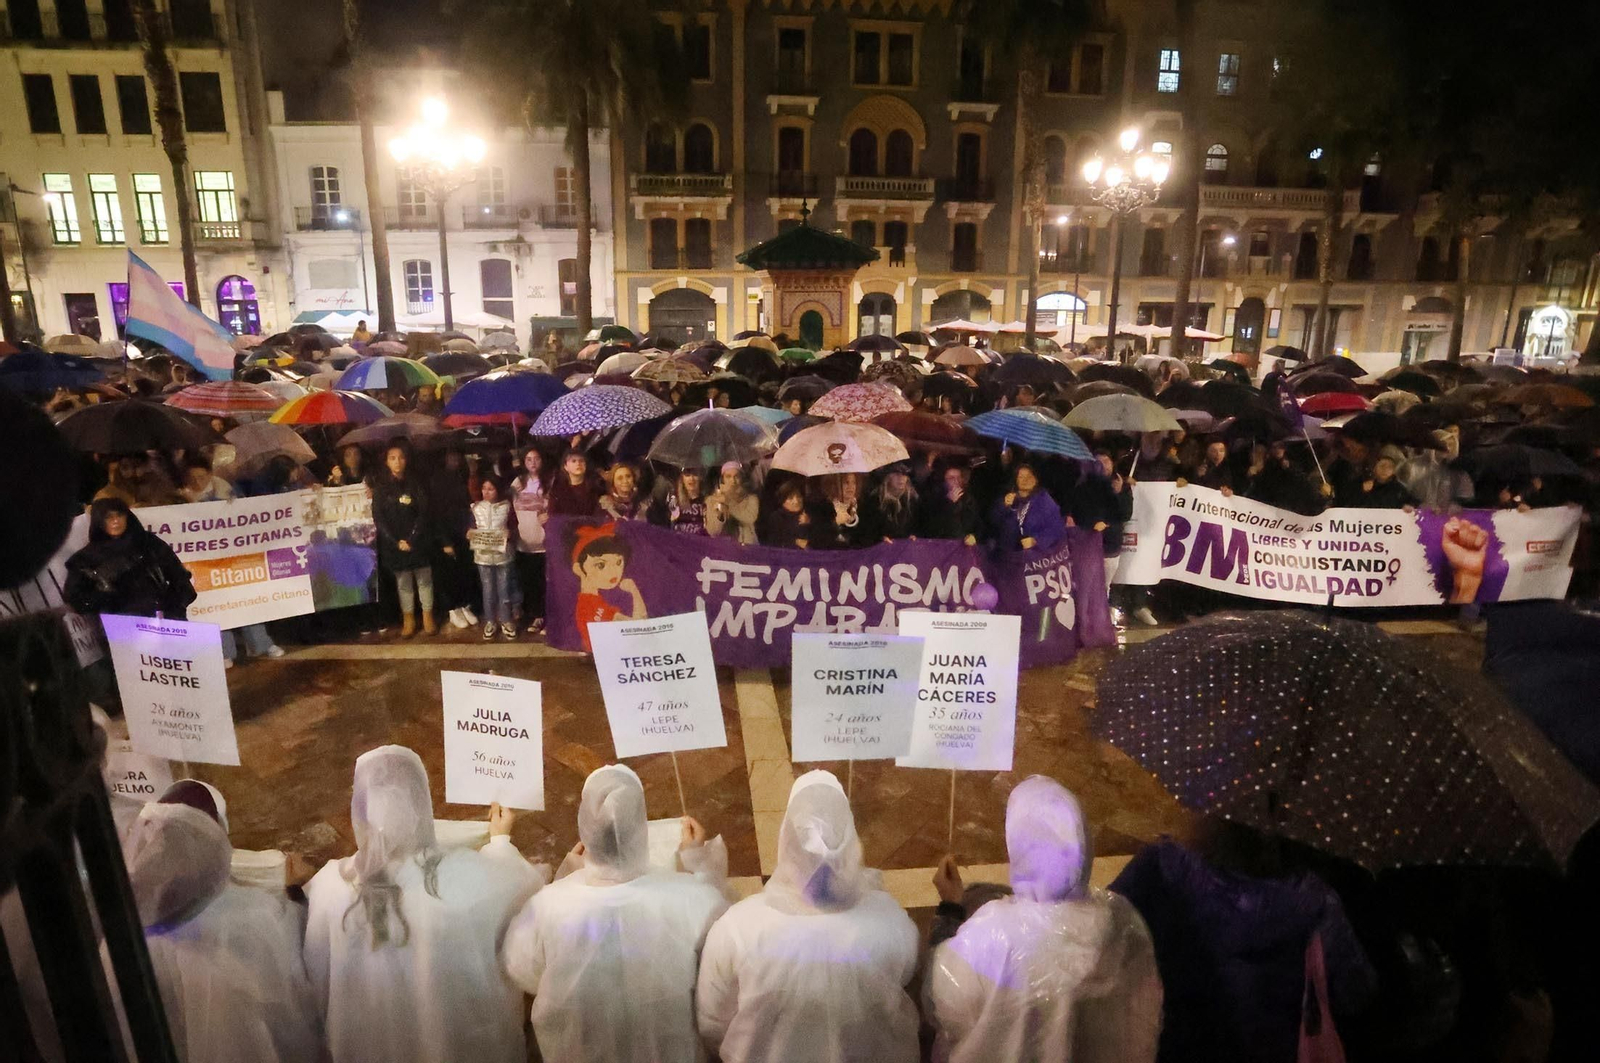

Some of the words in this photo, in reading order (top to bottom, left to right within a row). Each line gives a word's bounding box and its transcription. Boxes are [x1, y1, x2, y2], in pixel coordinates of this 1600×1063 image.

[181, 511, 270, 533] IGUALDAD
[274, 507, 293, 520] DE
[1191, 497, 1284, 529] Internacional
[1284, 523, 1303, 533] de
[1329, 519, 1403, 537] Mujeres
[170, 537, 229, 554] JERES
[233, 525, 303, 548] GITANAS
[1252, 532, 1297, 549] LIBRES
[1302, 540, 1312, 550] Y
[1317, 540, 1389, 555] UNIDAS,
[210, 565, 265, 587] Gitano
[1254, 569, 1383, 597] IGUALDAD
[1025, 563, 1072, 605] PSO
[190, 594, 269, 617] Secretariado
[272, 588, 310, 602] Gitano
[136, 623, 171, 633] ASESINADA
[620, 625, 656, 634] ASESINADA
[141, 654, 193, 672] LISBET
[621, 653, 686, 668] TERESA
[929, 655, 987, 668] JUANA
[140, 670, 201, 689] LASTRE
[617, 667, 697, 685] SÁNCHEZ
[813, 668, 898, 681] CRISTINA
[930, 670, 985, 686] MARÍA
[469, 679, 500, 688] ASESINADA
[826, 682, 885, 696] MARÍN
[918, 687, 997, 704] CÁCERES
[151, 702, 166, 715] 28
[169, 707, 201, 719] años
[637, 701, 653, 712] 47
[657, 700, 689, 711] años
[473, 708, 512, 723] JULIA
[651, 715, 680, 724] LEPE
[824, 712, 844, 723] 24
[847, 713, 882, 723] años
[928, 707, 946, 720] 35
[950, 709, 983, 721] años
[152, 719, 204, 732] AYAMONTE
[457, 720, 530, 740] MADRUGA
[641, 723, 695, 735] (HUELVA)
[837, 727, 867, 735] LEPE
[929, 724, 964, 732] ROCIANA
[966, 725, 982, 733] DEL
[823, 735, 881, 744] (HUELVA)
[934, 733, 976, 741] CONDADO
[472, 751, 487, 762] 56
[489, 755, 517, 767] años
[474, 766, 515, 780] HUELVA
